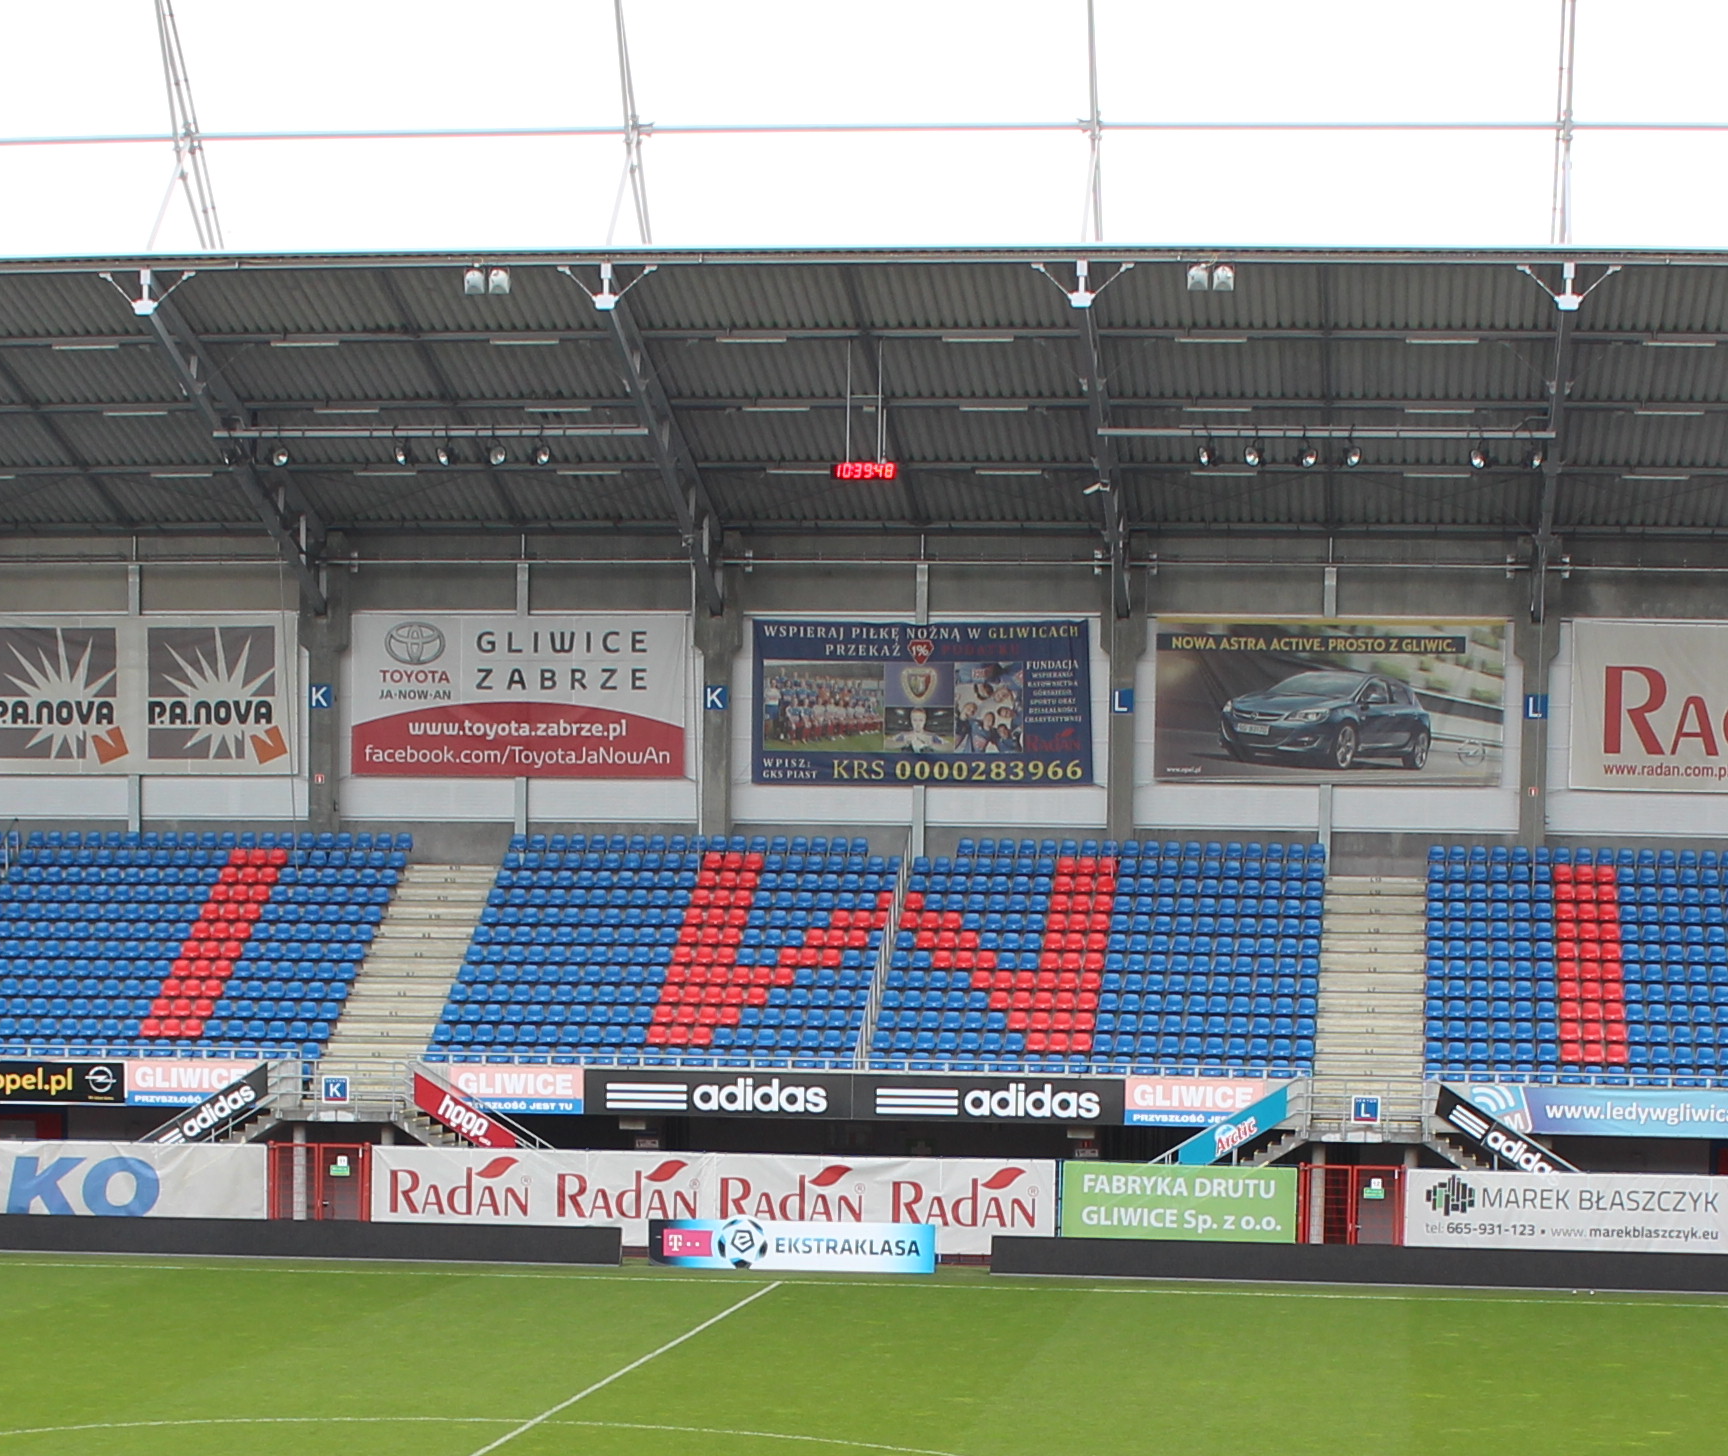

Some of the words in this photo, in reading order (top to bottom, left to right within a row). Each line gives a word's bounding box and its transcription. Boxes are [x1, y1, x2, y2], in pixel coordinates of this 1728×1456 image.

[835, 464, 894, 478] 10:39:48
[477, 631, 647, 653] GLIWICE
[764, 625, 845, 639] WSPIERAJ
[851, 627, 900, 642] PIŁKĘ
[906, 626, 960, 642] NOŻNĄ
[967, 628, 982, 639] W
[988, 626, 1079, 638] GLIWICACH
[825, 642, 901, 656] PRZEKAŻ
[1173, 636, 1217, 650] NOWA
[1220, 636, 1265, 651] ASTRA
[1270, 637, 1325, 651] ACTIVE.
[1329, 638, 1384, 652] PROSTO
[1390, 639, 1399, 652] Z
[1402, 639, 1456, 652] GLIWIC.
[1027, 659, 1079, 671] FUNDACJA
[380, 670, 450, 684] TOYOTA
[475, 668, 647, 691] ZABRZE
[312, 688, 327, 707] K
[707, 688, 723, 708] K
[408, 720, 627, 740] www.toyota.zabrze.pl
[364, 745, 670, 768] facebook.com/ToyotaJaNowAn
[763, 759, 812, 769] WPISZ:
[763, 770, 784, 779] GKS
[787, 771, 817, 779] PIAST
[833, 759, 885, 779] KRS
[896, 759, 1083, 780] 0000283966
[458, 1072, 573, 1095] GLIWICE
[530, 1102, 556, 1110] JEST
[692, 1078, 828, 1114] adidas
[964, 1083, 1101, 1119] adidas
[1133, 1084, 1253, 1109] GLIWICE
[183, 1085, 256, 1136] adidas
[1133, 1114, 1204, 1123] PRZYSZŁOŚĆ
[1215, 1118, 1258, 1157] Arctic
[1083, 1174, 1188, 1197] FABRYKA
[1194, 1177, 1276, 1199] DRUTU
[1482, 1188, 1570, 1210] MAREK
[1579, 1190, 1719, 1213] BŁASZCZYK
[1081, 1206, 1178, 1228] GLIWICE
[1184, 1210, 1217, 1231] Sp.
[1224, 1215, 1234, 1230] z
[1240, 1215, 1282, 1232] o.o.
[1447, 1222, 1536, 1238] 665-931-123
[776, 1237, 920, 1257] EKSTRAKLASA
